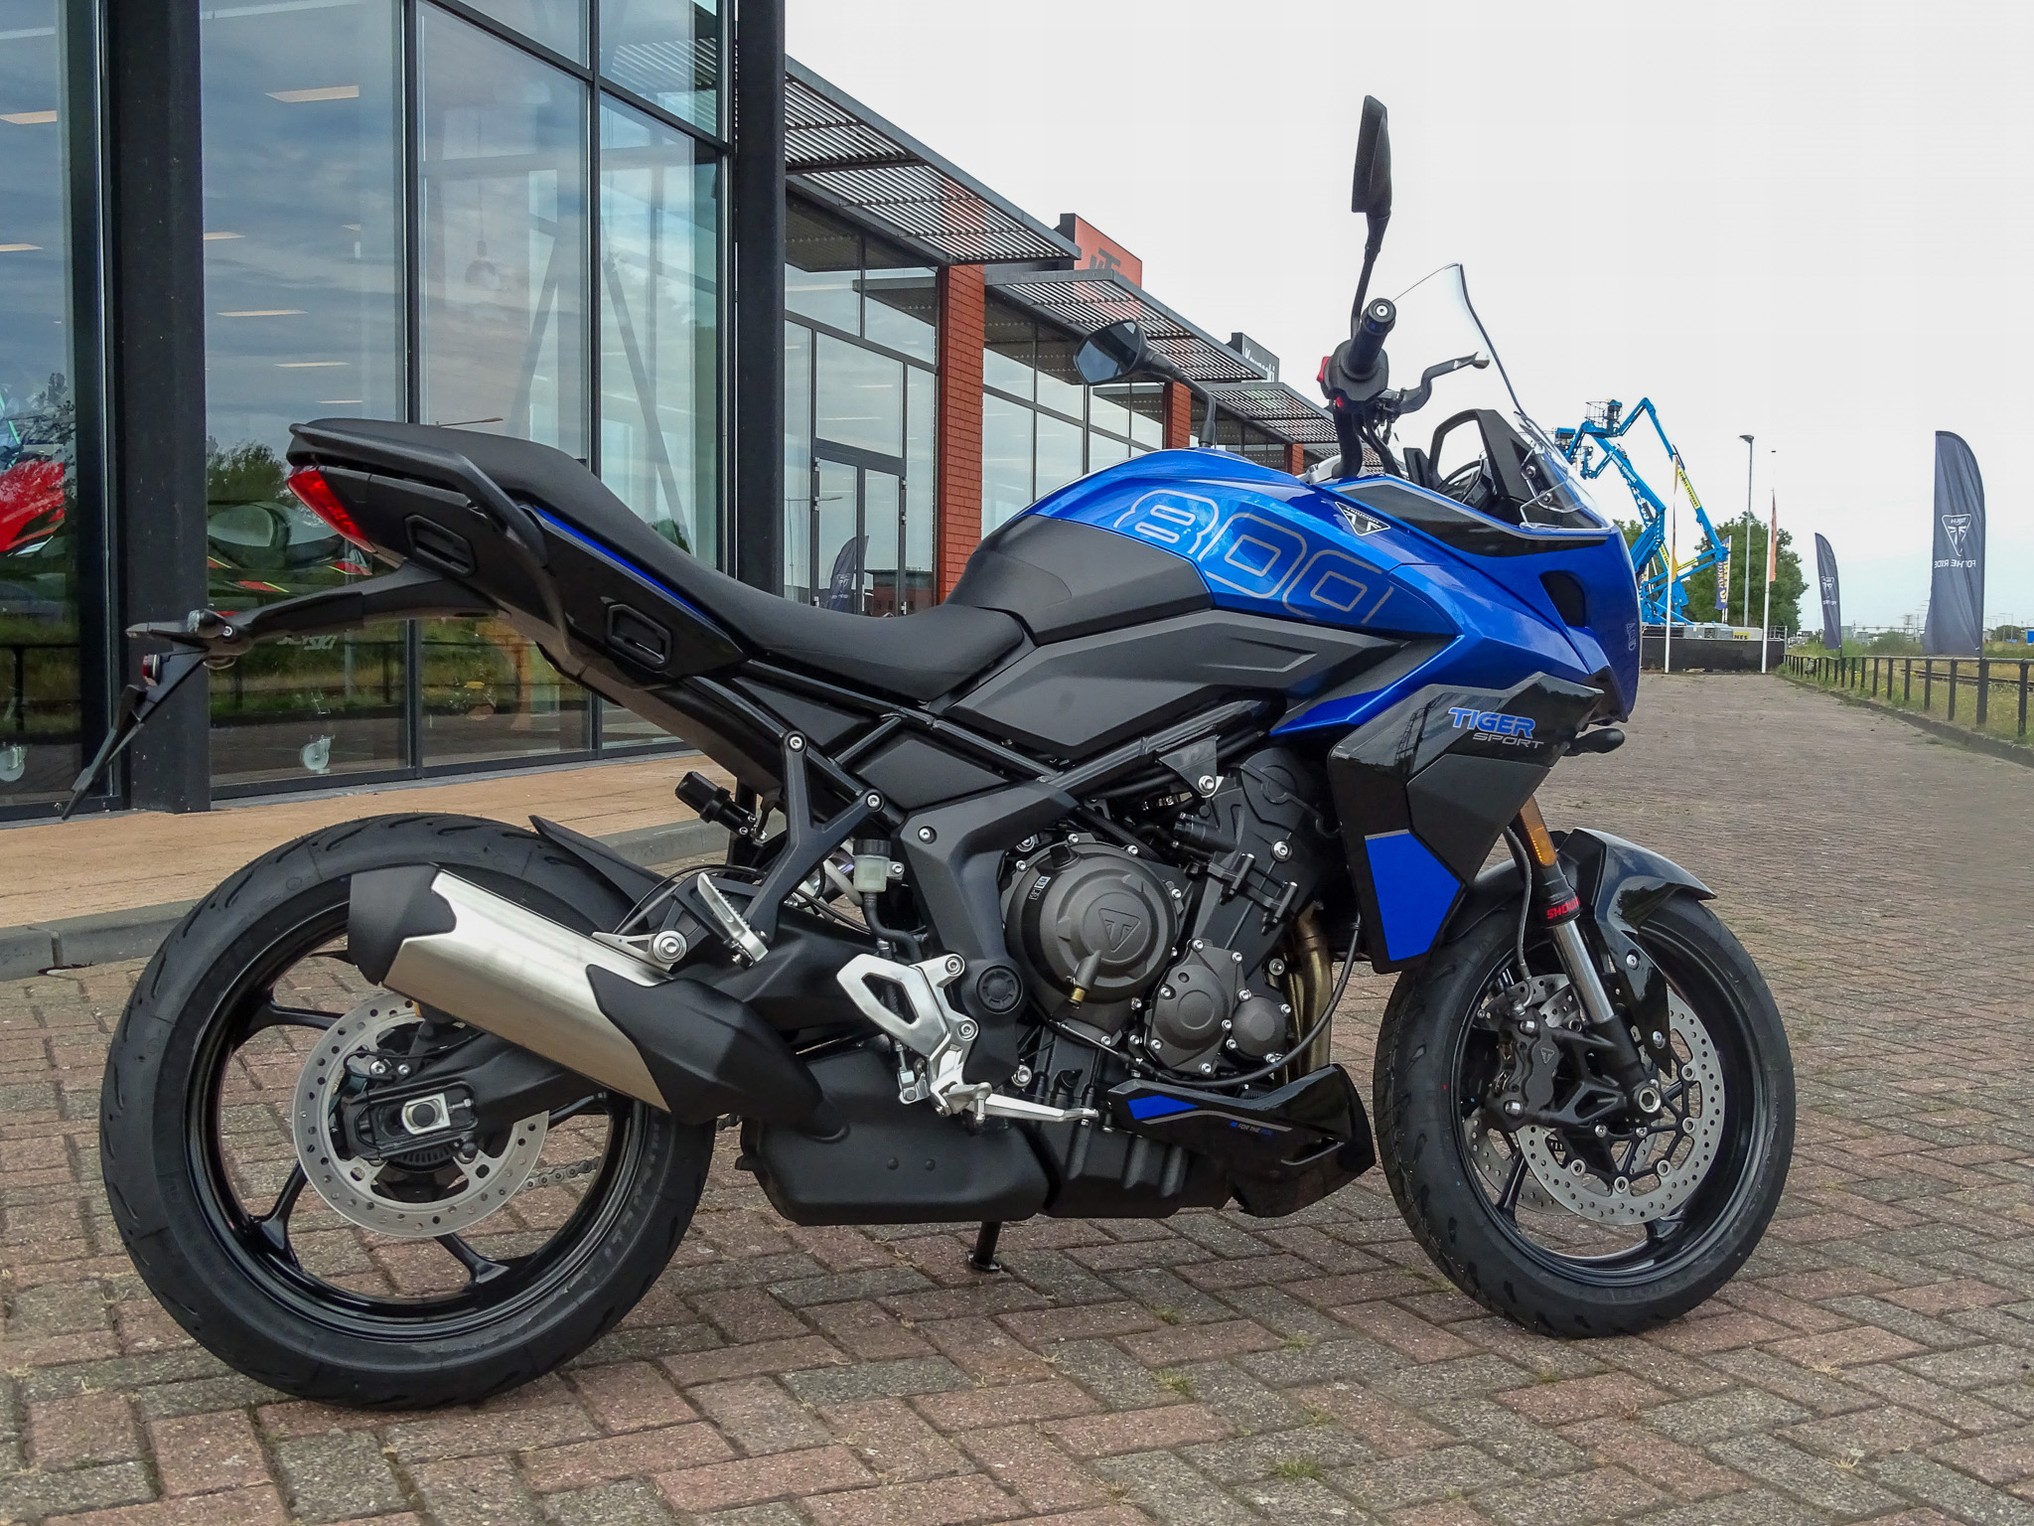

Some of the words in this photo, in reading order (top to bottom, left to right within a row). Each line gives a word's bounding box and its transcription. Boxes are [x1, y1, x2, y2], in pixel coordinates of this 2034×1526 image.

[1113, 489, 1394, 624] 800
[1448, 706, 1536, 740] TIGER
[1472, 732, 1545, 749] SPORT
